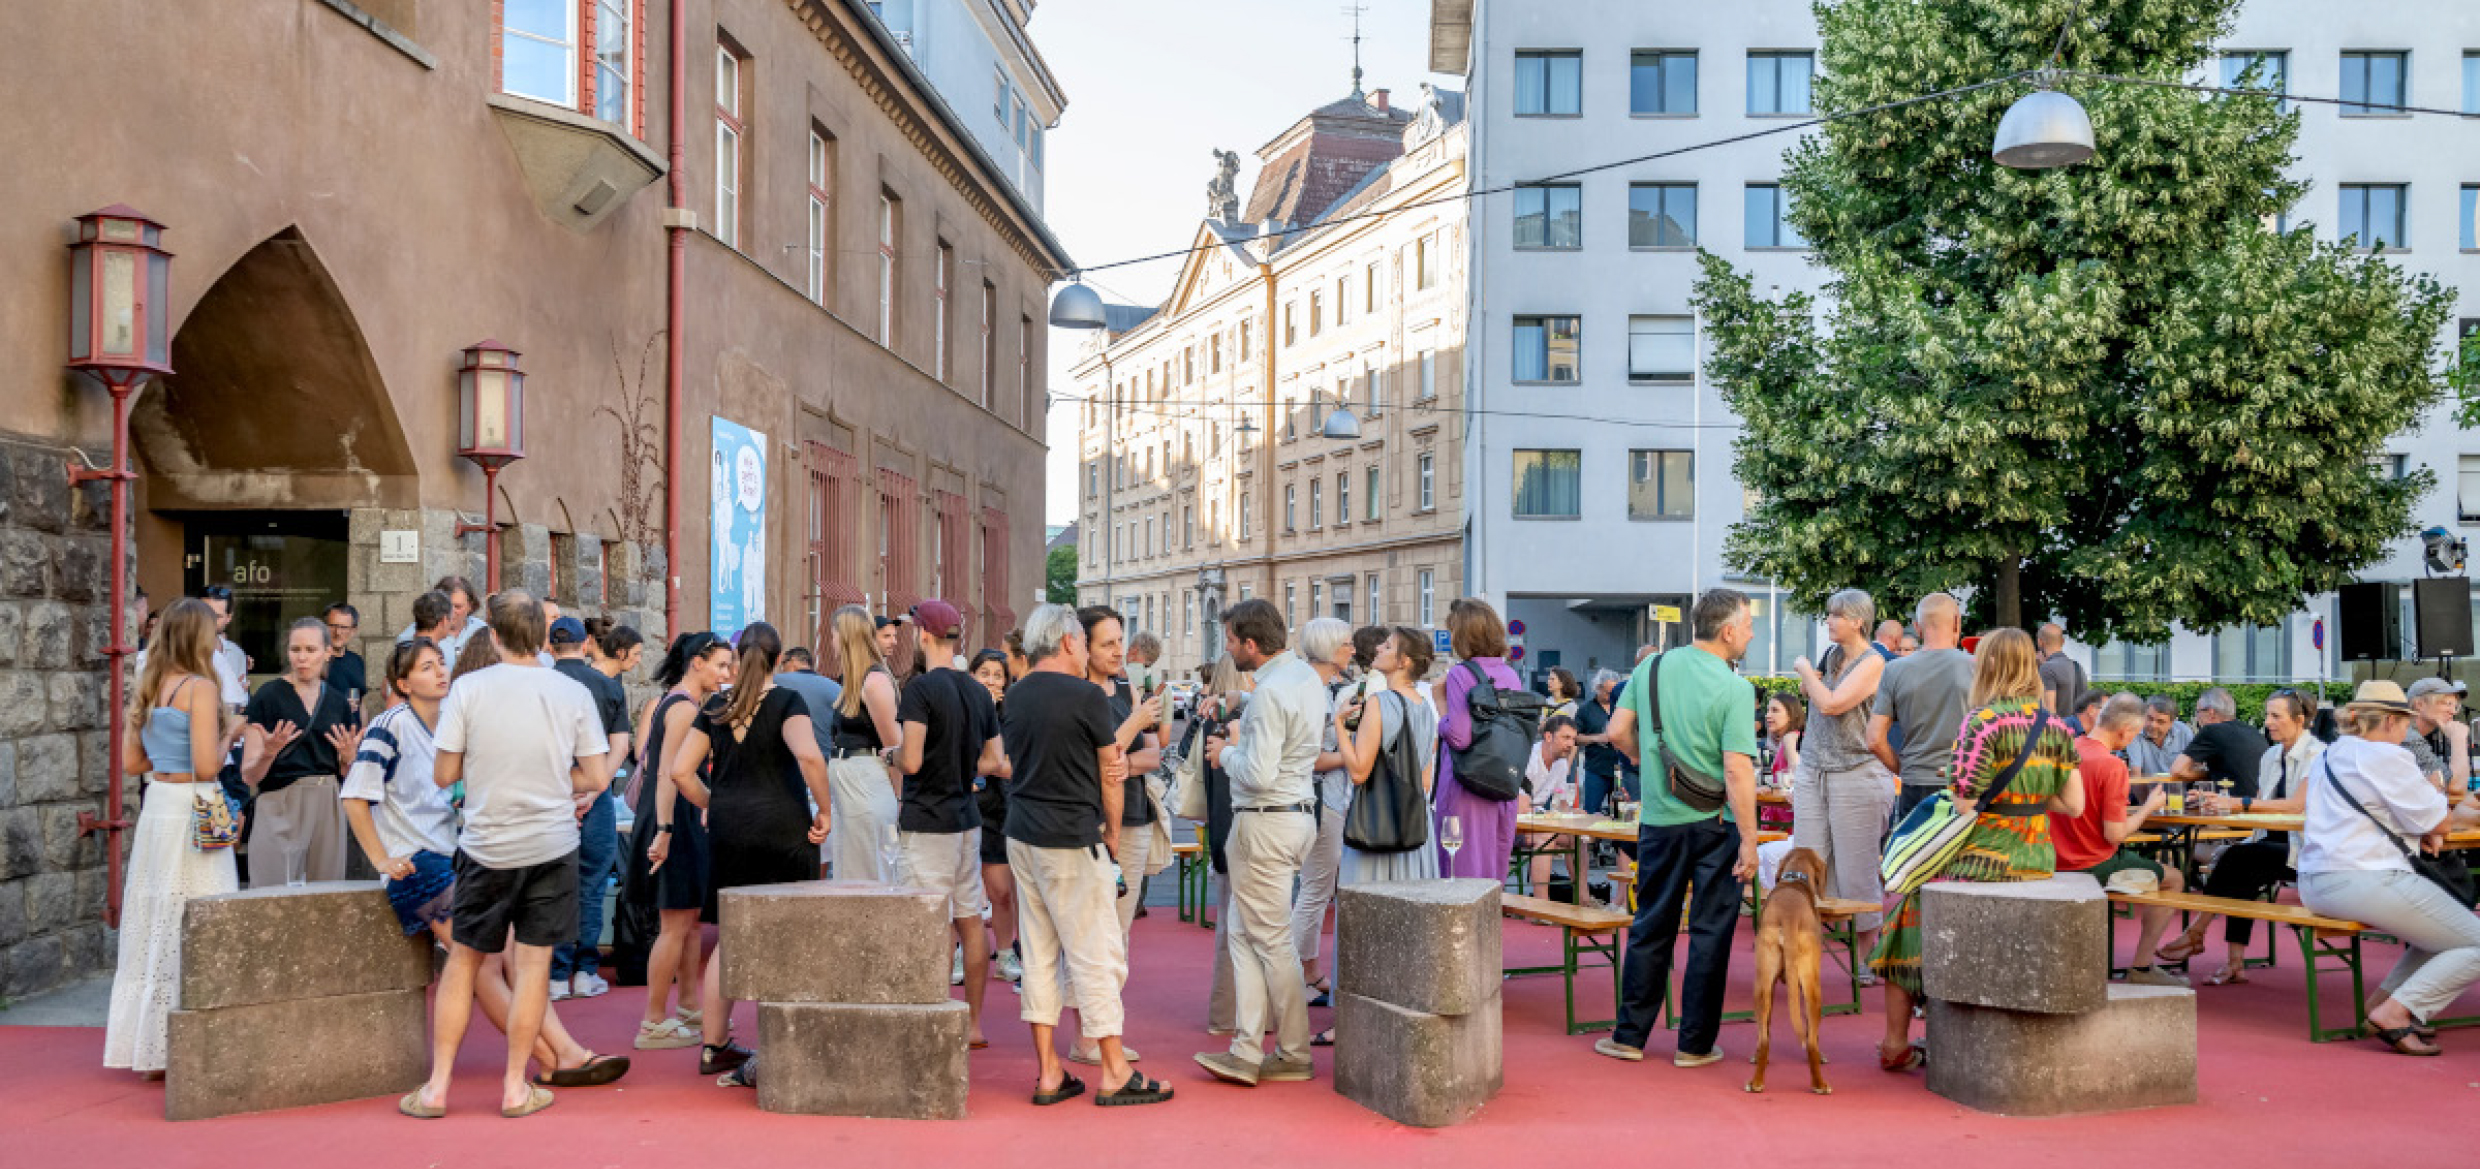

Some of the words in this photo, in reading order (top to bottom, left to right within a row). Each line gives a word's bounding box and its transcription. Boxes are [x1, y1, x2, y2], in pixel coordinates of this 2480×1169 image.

[397, 535, 402, 552] 1
[234, 560, 271, 583] afo
[1437, 631, 1447, 645] P
